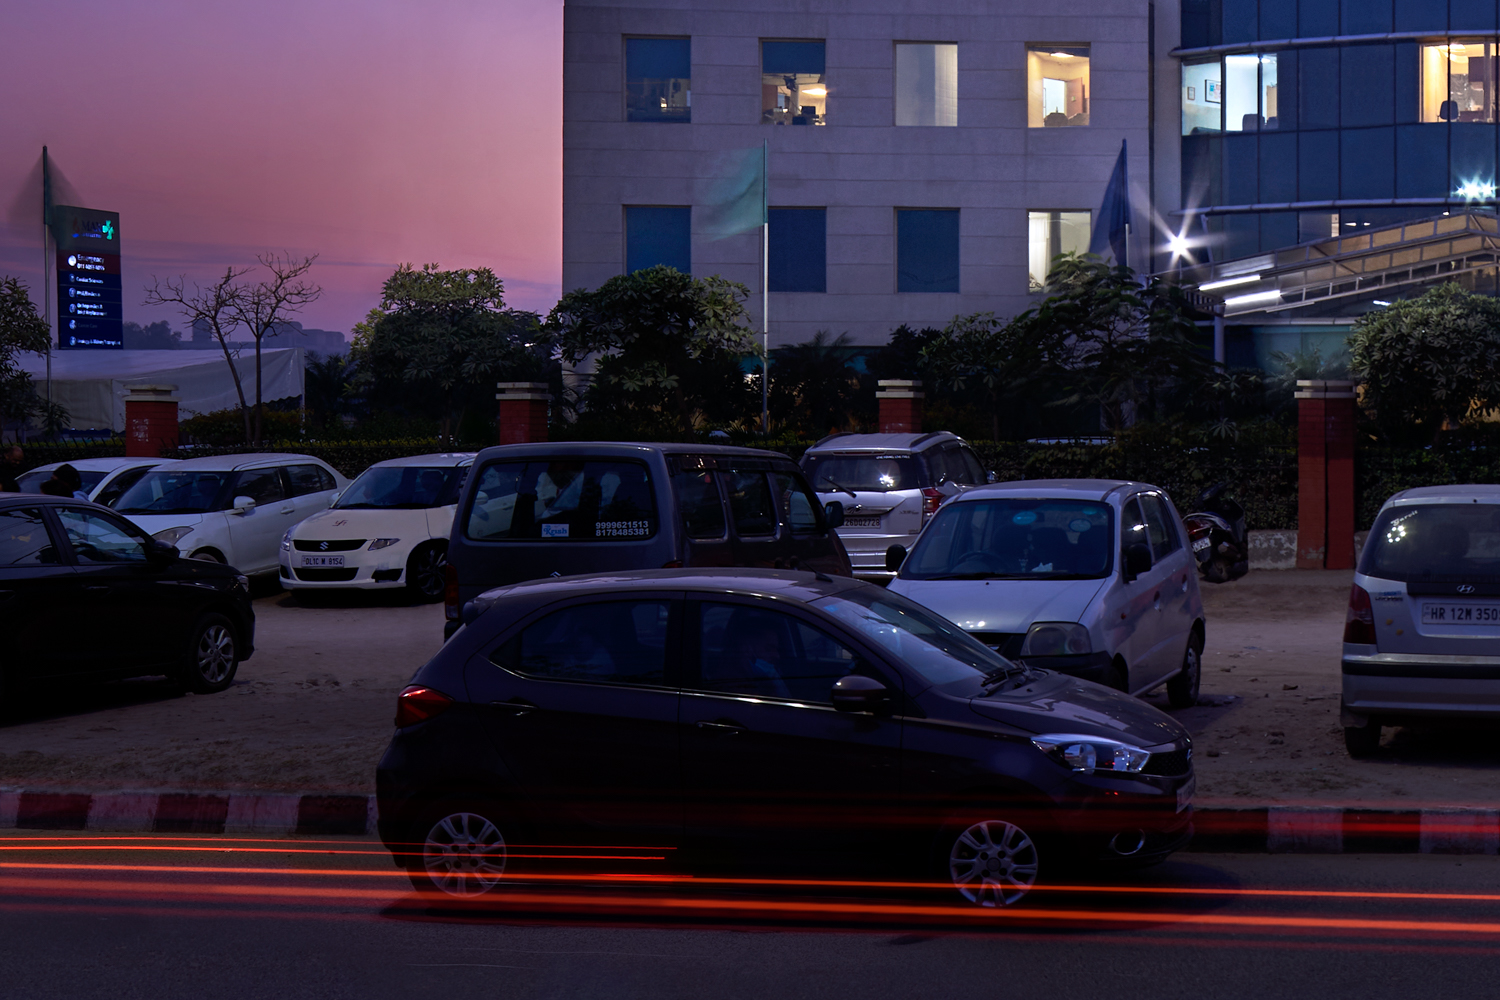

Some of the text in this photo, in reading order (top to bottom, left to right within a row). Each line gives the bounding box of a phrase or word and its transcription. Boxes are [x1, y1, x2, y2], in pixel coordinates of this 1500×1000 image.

[595, 521, 649, 529] 9999621513
[595, 528, 649, 537] 8178485381
[1431, 608, 1446, 620] HR
[1451, 608, 1472, 620] 12M
